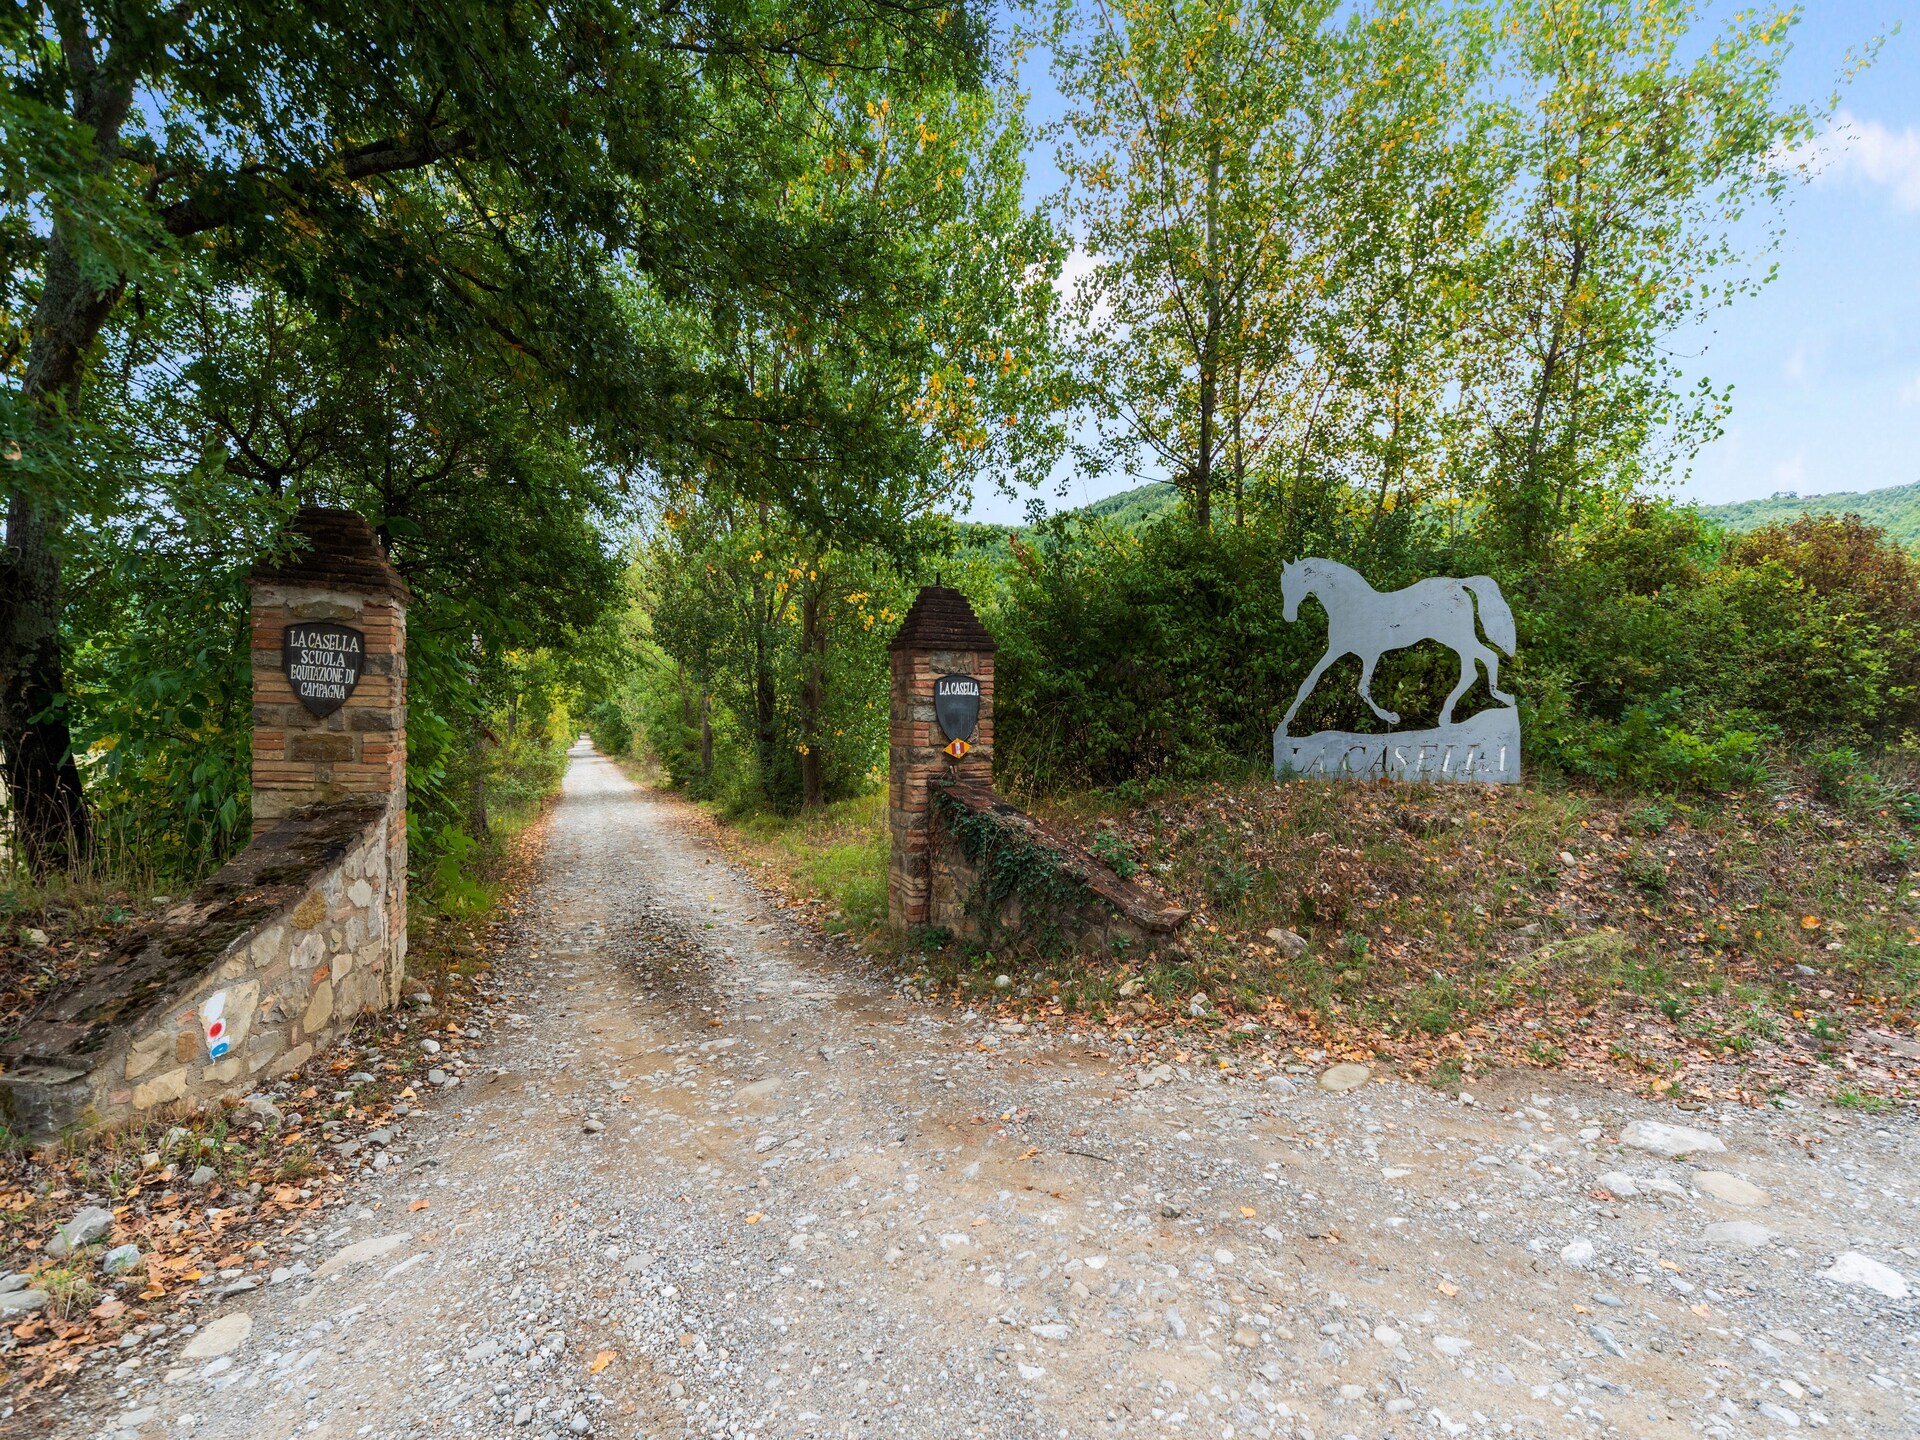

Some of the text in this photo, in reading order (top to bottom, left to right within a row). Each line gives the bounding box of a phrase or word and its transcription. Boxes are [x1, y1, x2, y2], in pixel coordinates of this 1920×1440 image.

[290, 630, 360, 653] LA CASELLA
[300, 649, 346, 667] SCUOLA
[290, 664, 355, 685] EQUITAZIONE DI
[300, 682, 346, 700] CAMPAGNA
[939, 681, 980, 696] LA CASELLA
[1291, 746, 1326, 774] LA
